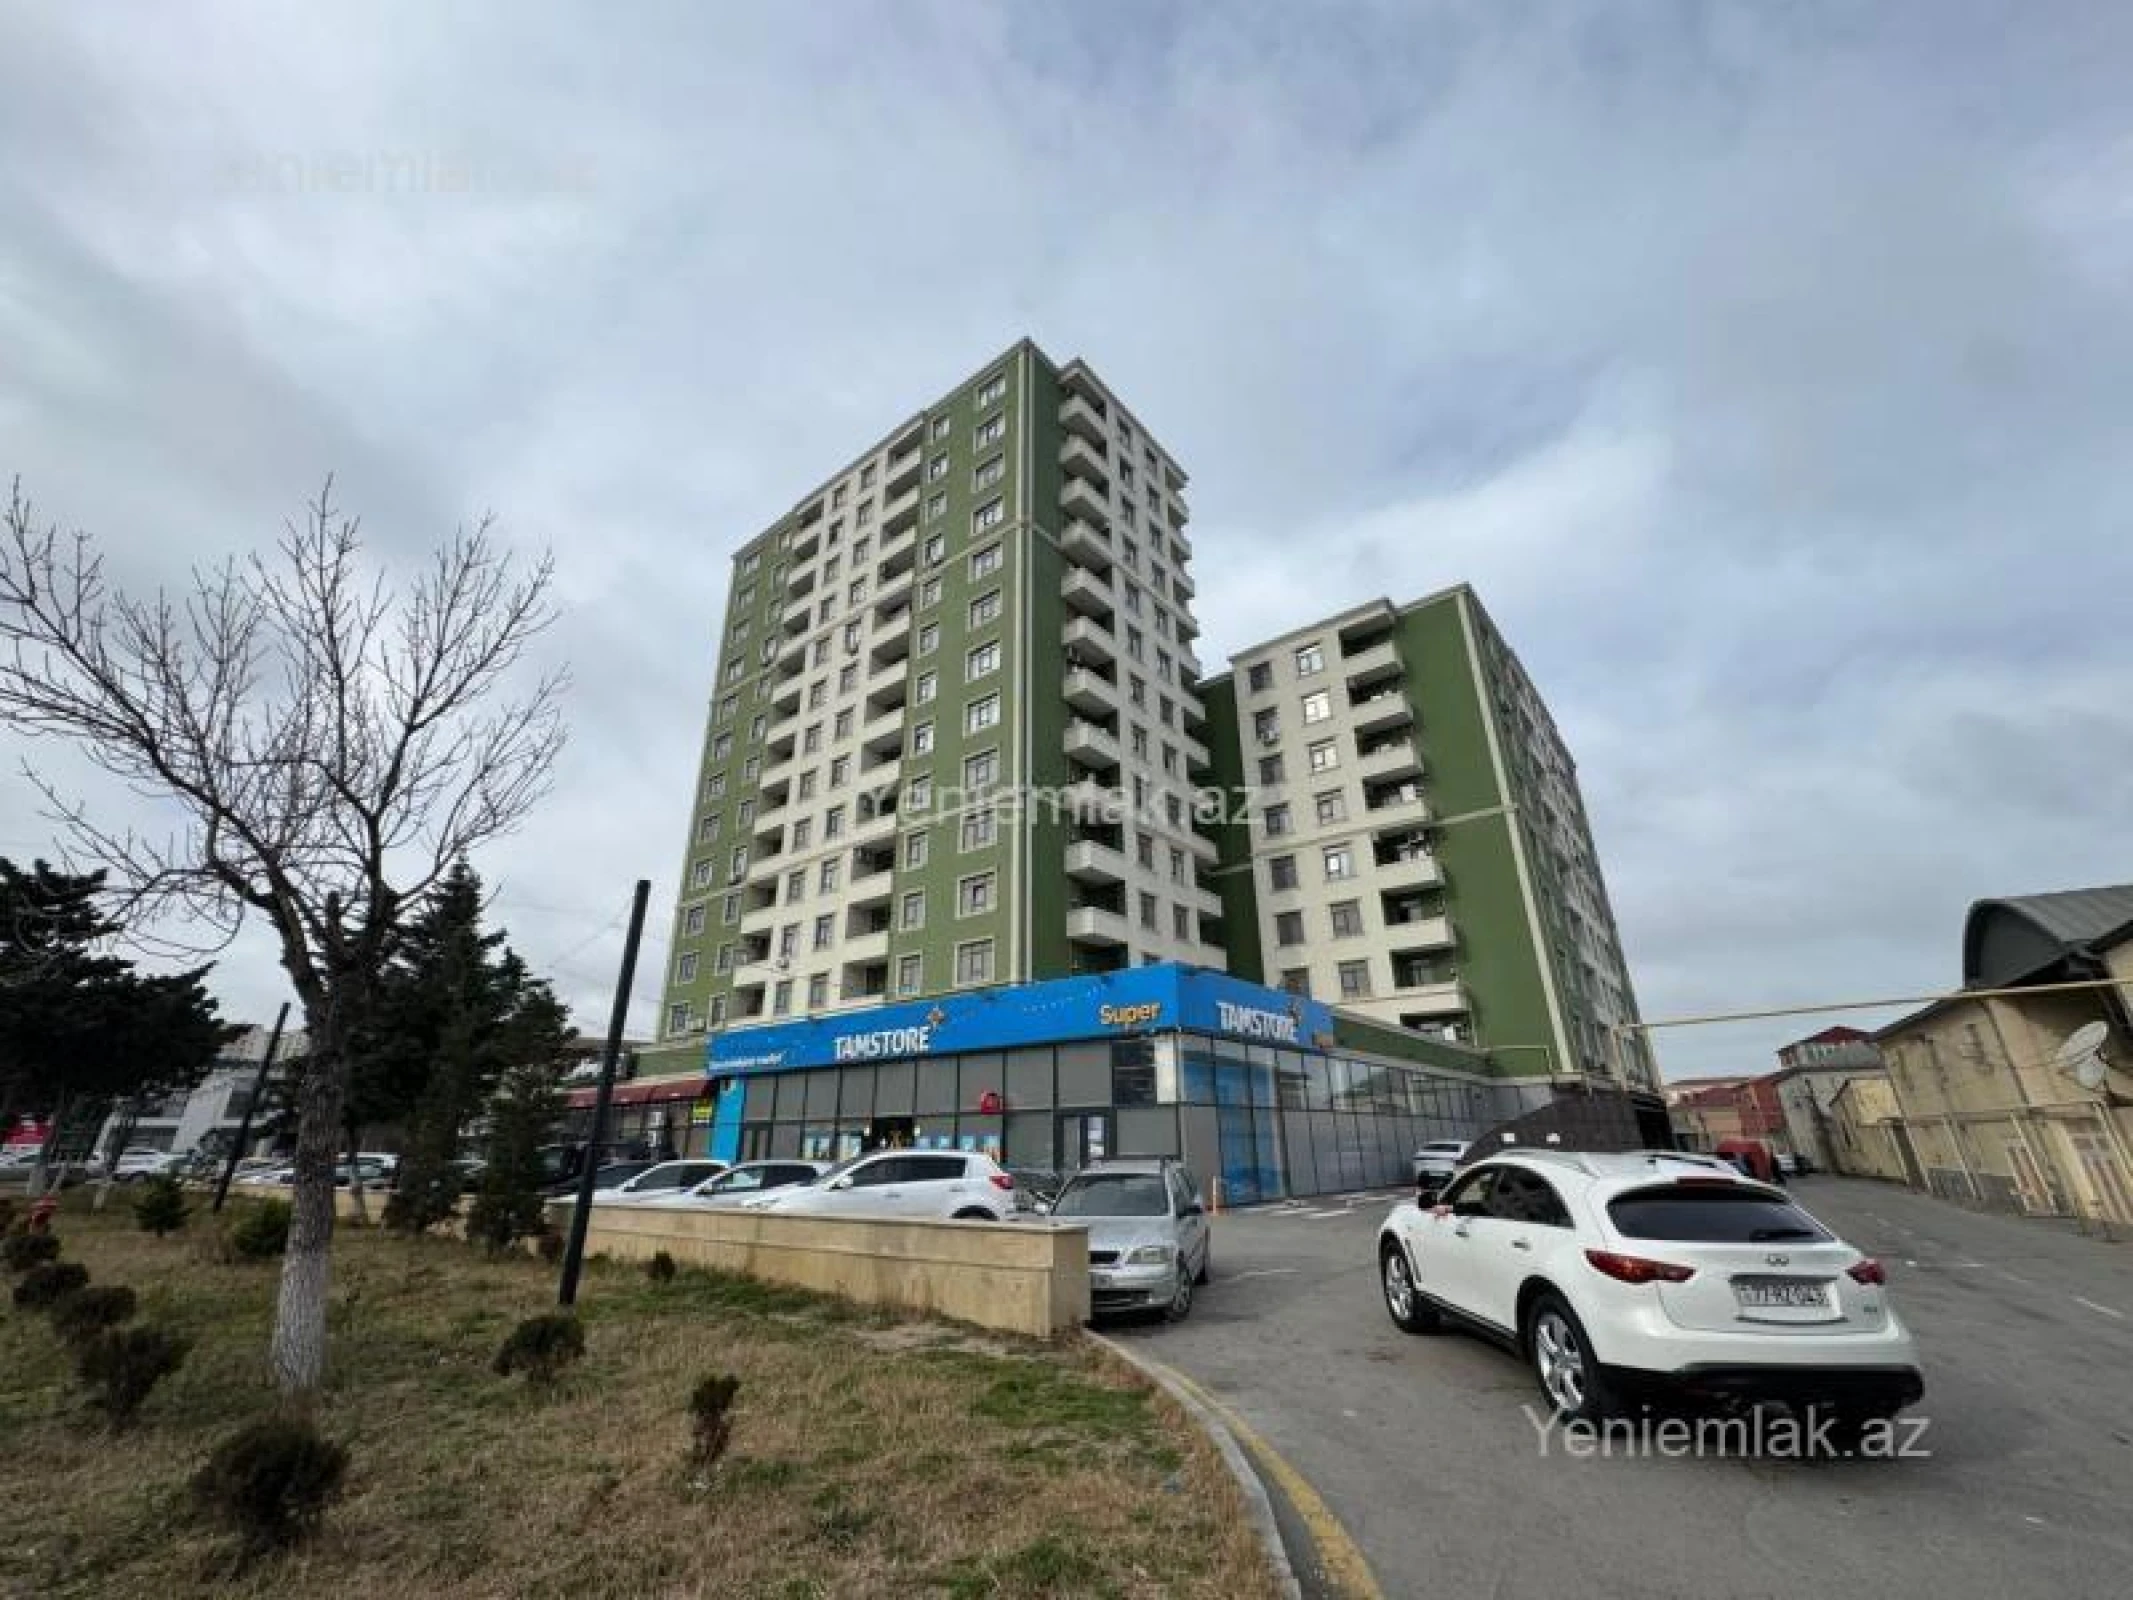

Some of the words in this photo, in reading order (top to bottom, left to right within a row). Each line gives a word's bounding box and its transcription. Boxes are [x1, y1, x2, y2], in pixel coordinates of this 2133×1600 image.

[1100, 1002, 1161, 1027] Super
[1216, 1000, 1299, 1044] TAMSTORE
[834, 1026, 930, 1059] TAMSTORE
